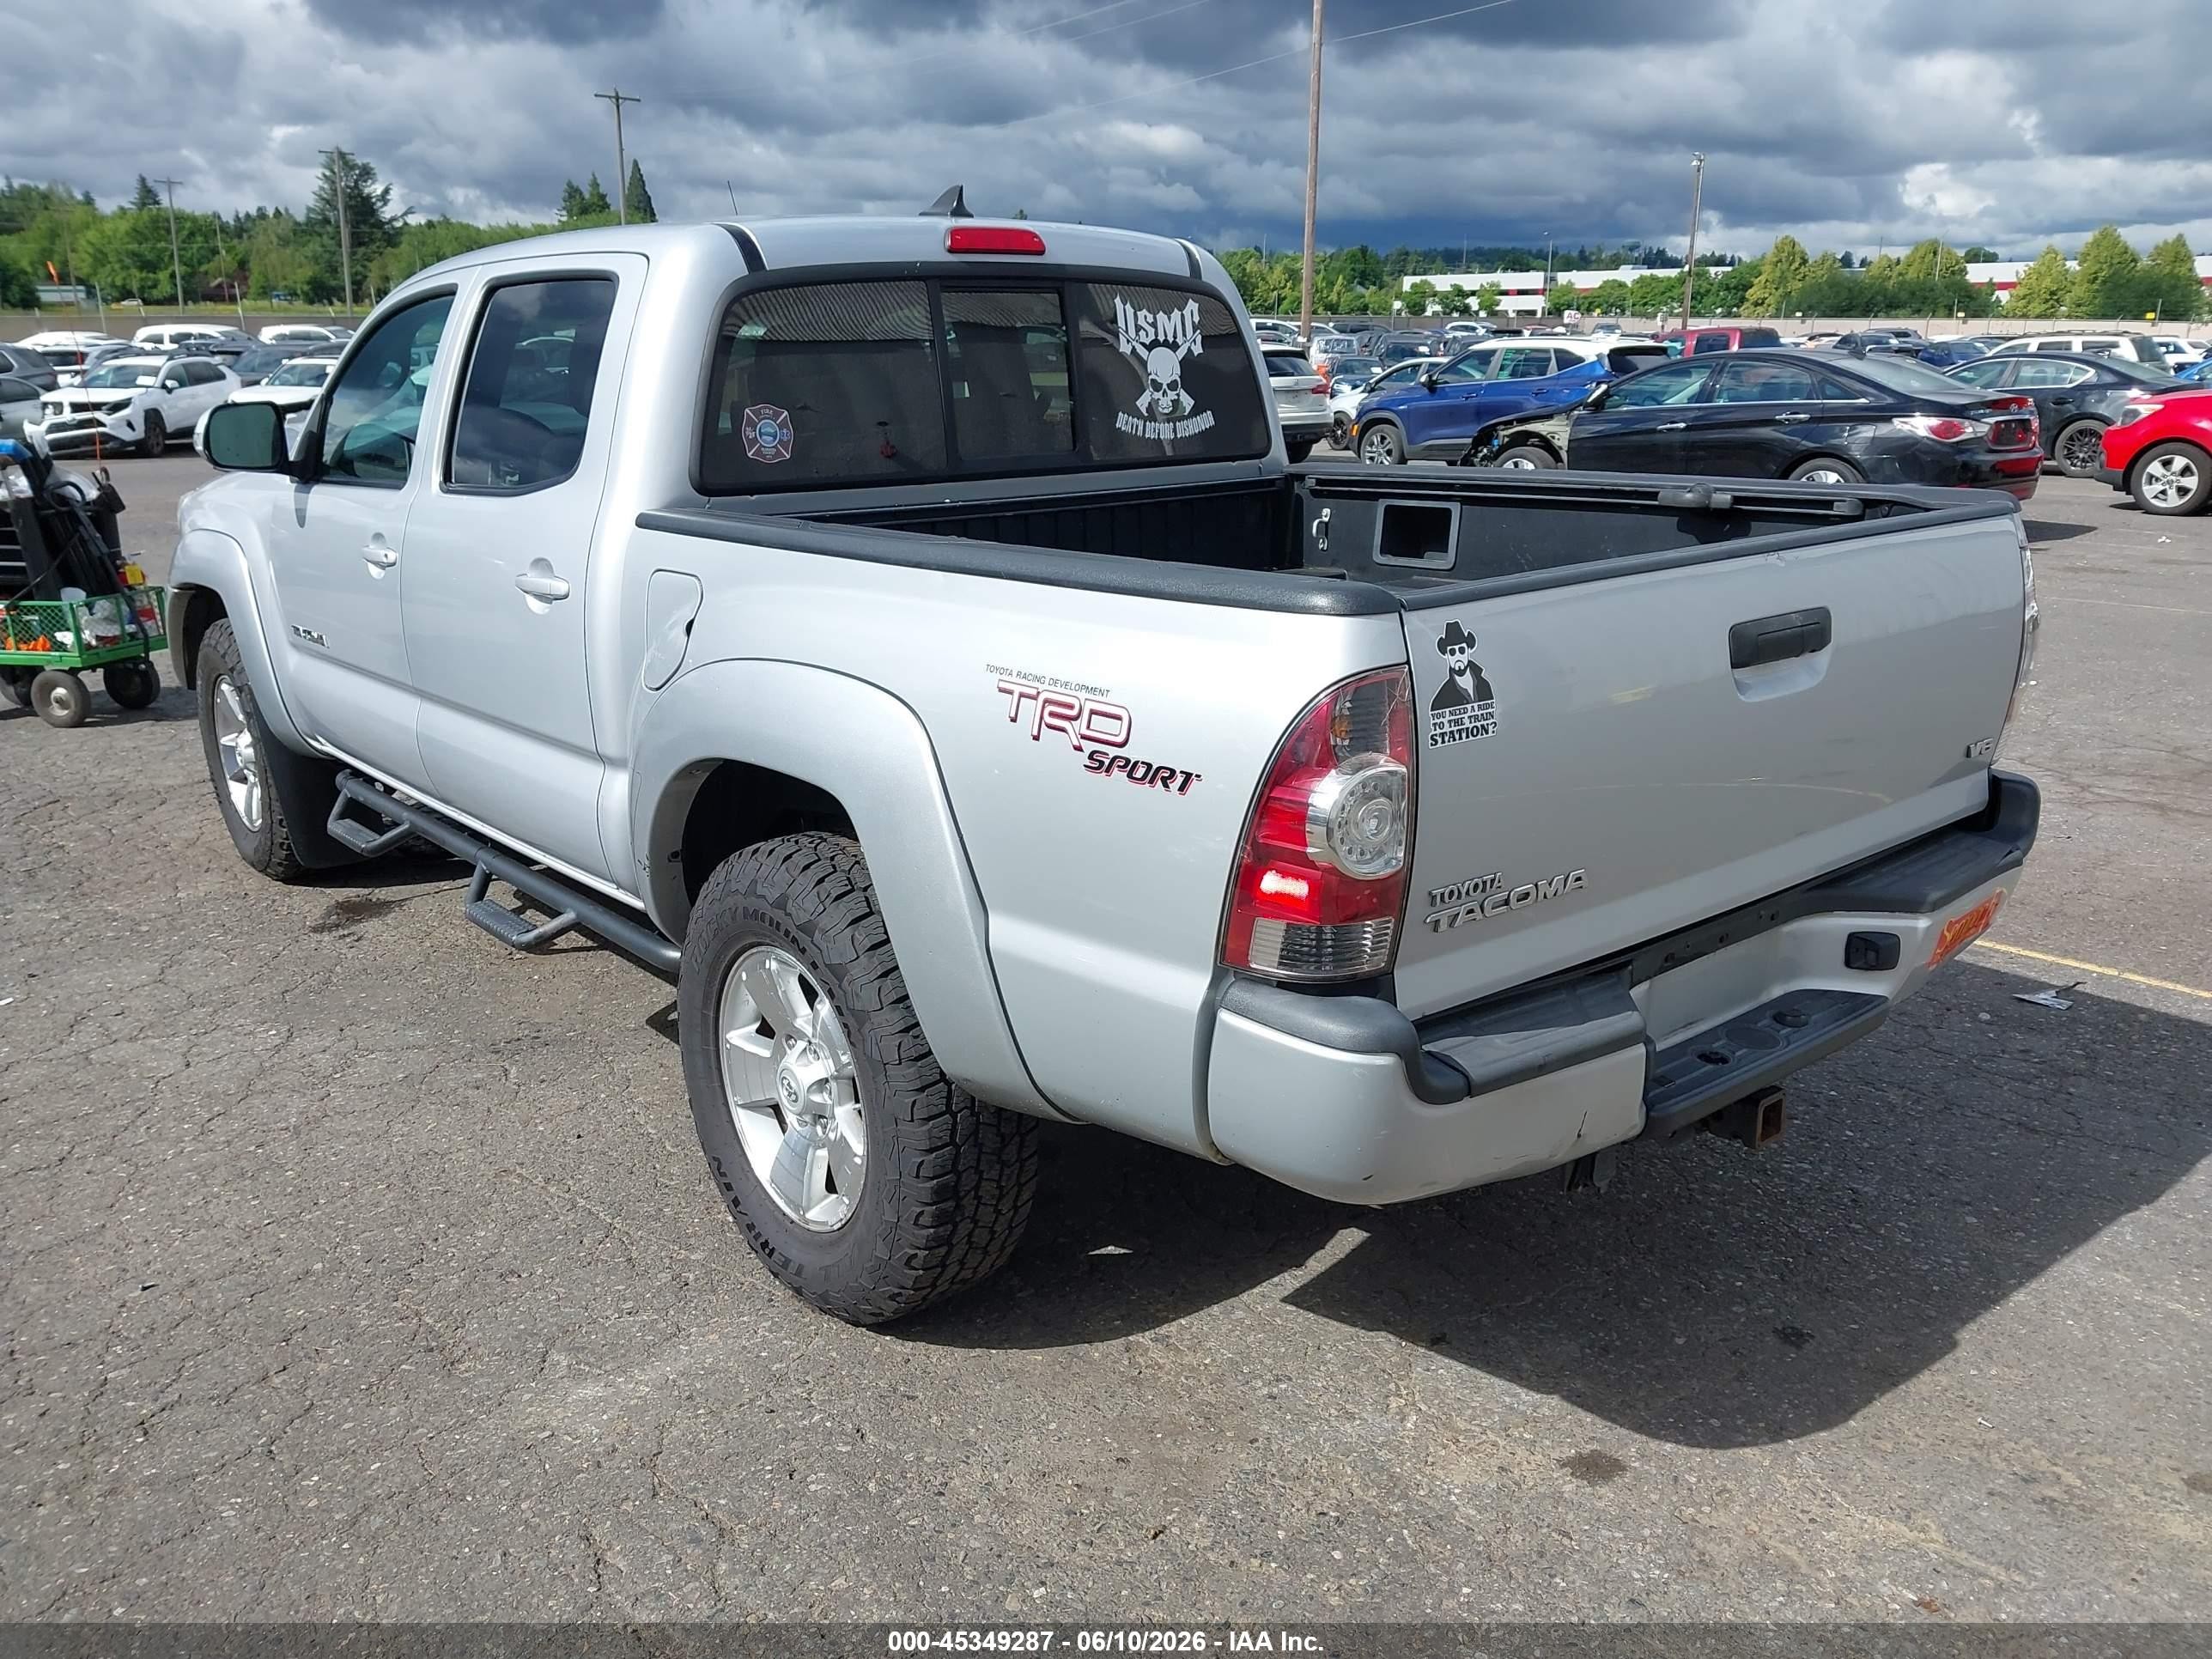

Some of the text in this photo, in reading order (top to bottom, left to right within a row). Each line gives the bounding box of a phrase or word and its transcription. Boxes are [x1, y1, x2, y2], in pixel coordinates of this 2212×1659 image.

[1115, 294, 1204, 356] USMC
[1116, 410, 1215, 440] DEATH BEFORE DISHONOR
[986, 664, 1110, 698] TOYOTA RACING DEVELOPMENT
[997, 678, 1132, 752] TRD
[1431, 711, 1446, 720] YOU
[1449, 707, 1468, 717] NEED
[1477, 702, 1495, 711] RIDE
[1432, 711, 1494, 732] TO THE TRAIN
[1430, 721, 1498, 746] STATION?
[1083, 750, 1202, 795] SPORT
[1425, 868, 1588, 933] TACOMA
[1429, 872, 1502, 907] TOYOTA
